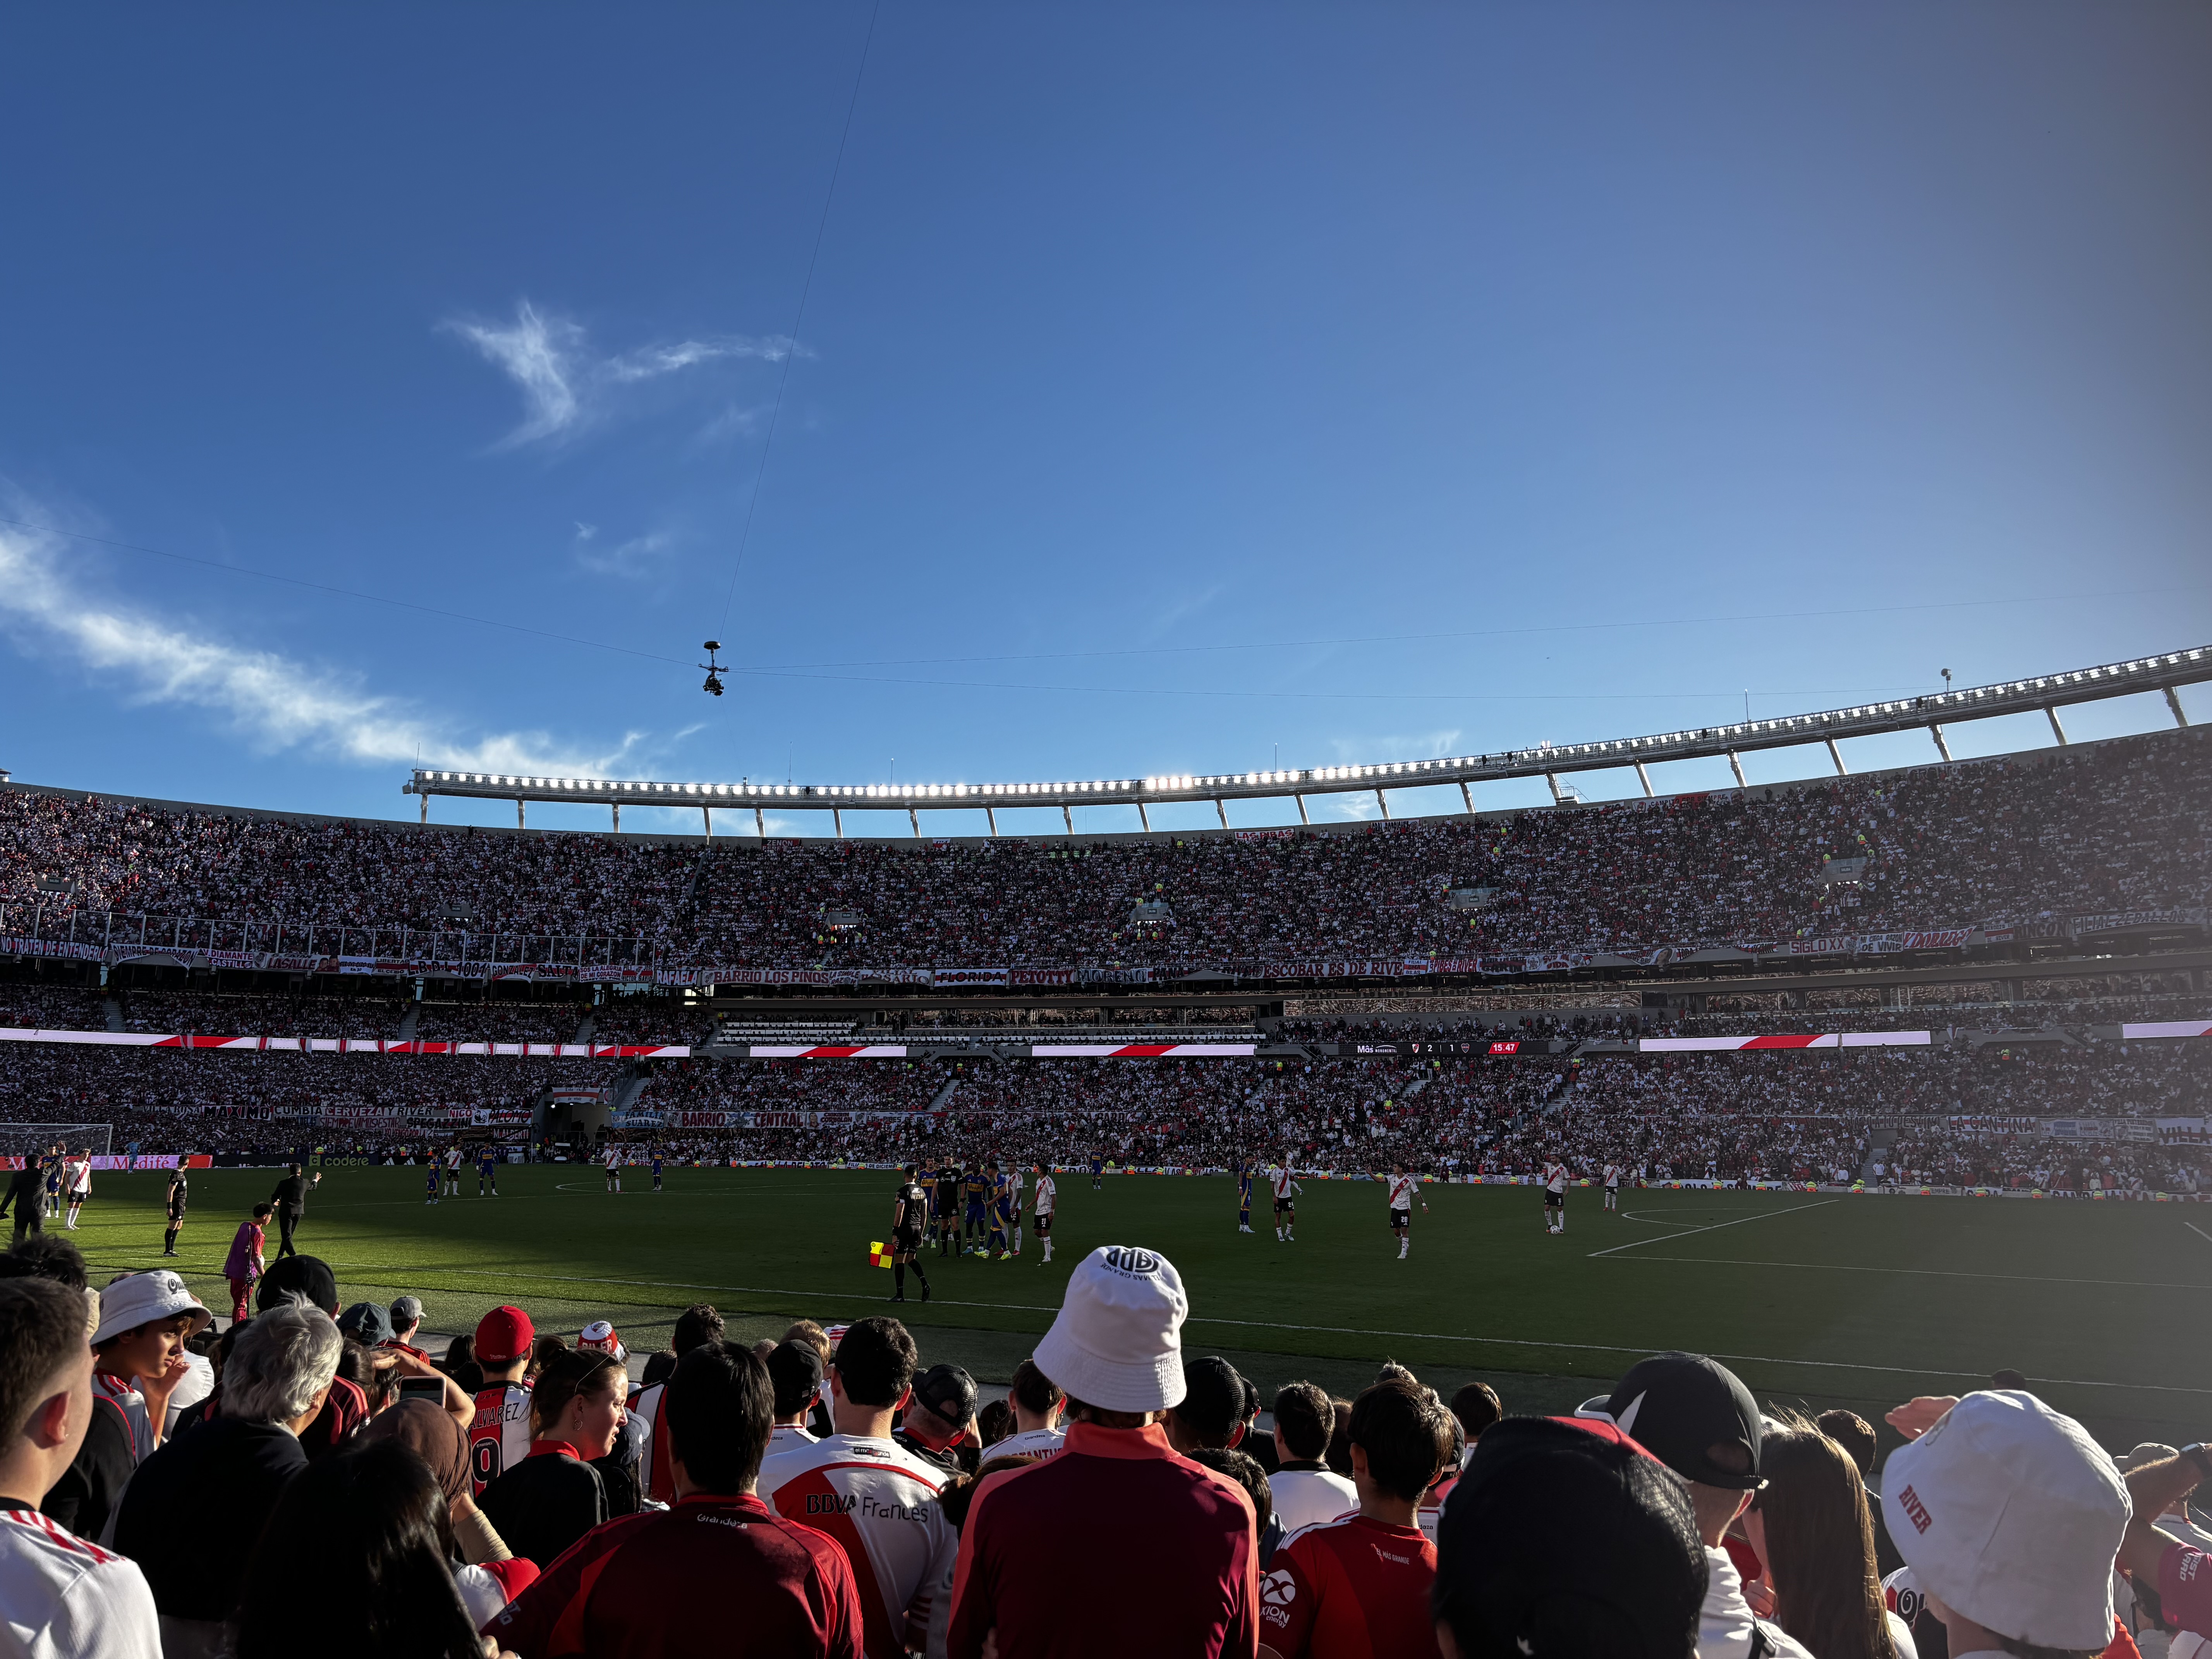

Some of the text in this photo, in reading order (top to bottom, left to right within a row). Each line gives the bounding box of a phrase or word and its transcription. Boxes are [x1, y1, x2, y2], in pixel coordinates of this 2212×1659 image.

[2073, 915, 2110, 934] FILIAL
[1, 936, 109, 962] NO TRATEN DE ENTENDERLO
[1791, 940, 1827, 954] SIGLO
[1829, 937, 1844, 951] XX
[1862, 941, 1903, 952] DE VIVIR
[113, 945, 147, 962] SIEMPRE
[211, 950, 253, 960] DIAMANTE
[492, 964, 535, 979] GONZALEZ
[1263, 963, 1324, 978] ESCOBAR
[1328, 962, 1345, 976] ES
[1348, 962, 1367, 975] DE
[1370, 961, 1404, 975] RIVE
[1434, 959, 1452, 972] PIBES
[1458, 958, 1478, 972] RIVER
[658, 970, 697, 986] RAFAELA
[713, 970, 829, 984] BARRIO LOS PINOS
[940, 972, 1003, 983] FLORIDA
[1011, 969, 1075, 984] PETOTTY
[1076, 969, 1147, 983] MORENO
[204, 1106, 270, 1119] MAXIMO
[325, 1107, 383, 1116] CERVEZA
[449, 1109, 472, 1118] NICO
[489, 1109, 530, 1124] PALOMO
[625, 1111, 665, 1119] FAMILIA
[626, 1119, 663, 1127] SUAREZ
[682, 1112, 726, 1127] BARRIO
[754, 1112, 804, 1128] CENTRAL
[1948, 1116, 1964, 1130] LA
[1970, 1116, 2034, 1133] CANTINA
[325, 1154, 369, 1167] codere
[471, 1402, 520, 1430] ALVAREZ
[806, 1494, 856, 1514] BBVA
[1899, 1484, 1932, 1535] RIVER
[1392, 1554, 1410, 1565] GRANDE
[1266, 1615, 1286, 1628] energy
